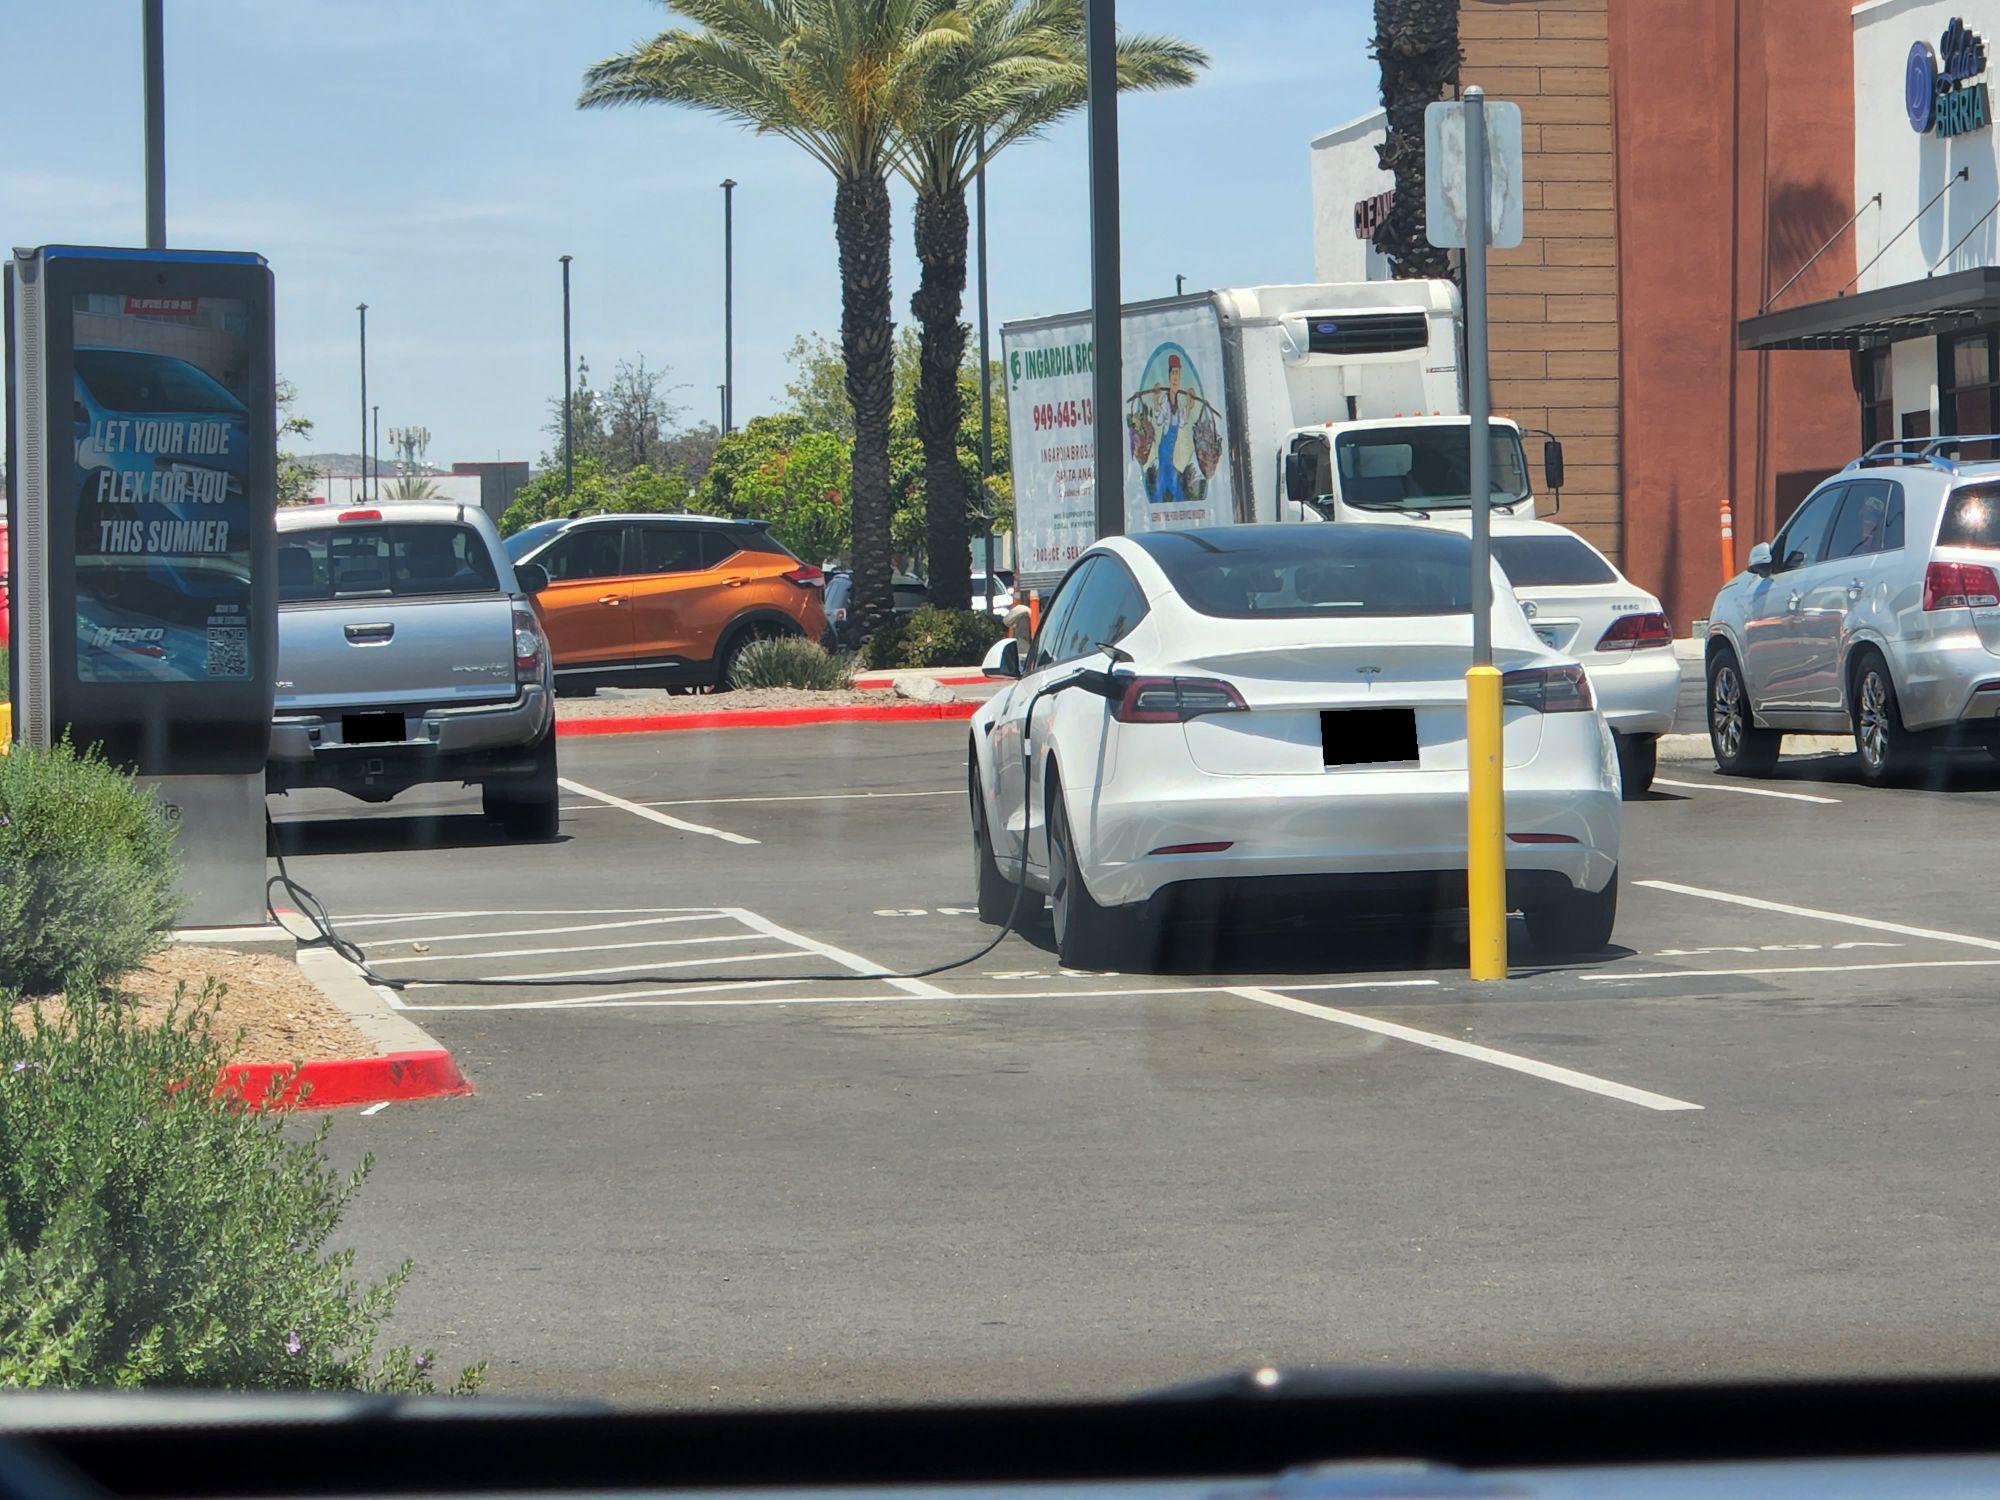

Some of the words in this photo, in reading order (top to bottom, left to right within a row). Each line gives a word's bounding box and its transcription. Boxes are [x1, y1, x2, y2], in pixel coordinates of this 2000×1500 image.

[1936, 85, 1987, 139] BIRRIA
[1025, 345, 1074, 380] INGARDIA
[93, 420, 130, 453] LET
[135, 421, 184, 454] YOUR
[187, 422, 231, 454] RIDE
[97, 470, 145, 503] FLEX
[149, 470, 187, 503] FOR
[192, 471, 228, 504] YOU
[100, 520, 143, 553] THIS
[147, 520, 229, 553] SUMMER
[91, 626, 165, 648] Maaco
